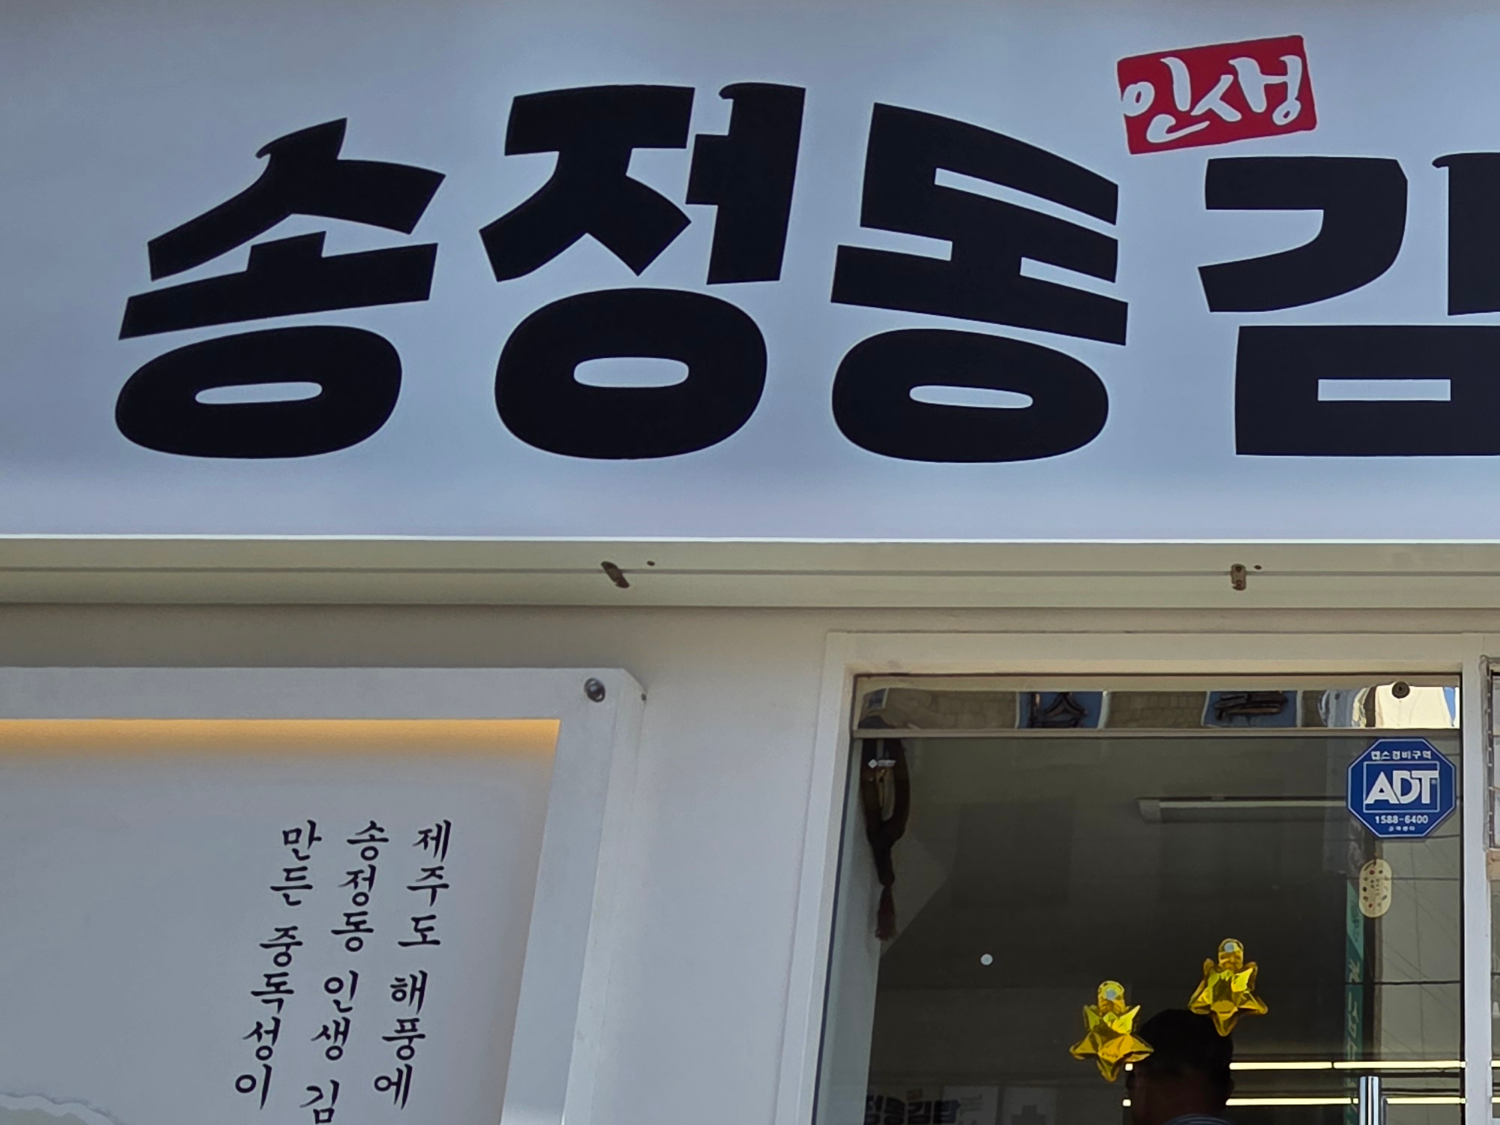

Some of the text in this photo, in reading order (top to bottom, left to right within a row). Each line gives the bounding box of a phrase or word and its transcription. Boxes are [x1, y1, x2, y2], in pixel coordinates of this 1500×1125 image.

[1120, 55, 1304, 136] 인생
[1365, 770, 1439, 804] ADT
[1375, 815, 1429, 824] 1588-6400
[269, 820, 322, 907] 만든
[331, 820, 389, 953] 송정동
[397, 819, 452, 948] 제주도
[234, 926, 304, 1109] 중독성이
[310, 970, 359, 1061] 인생
[373, 969, 430, 1109] 해풍에
